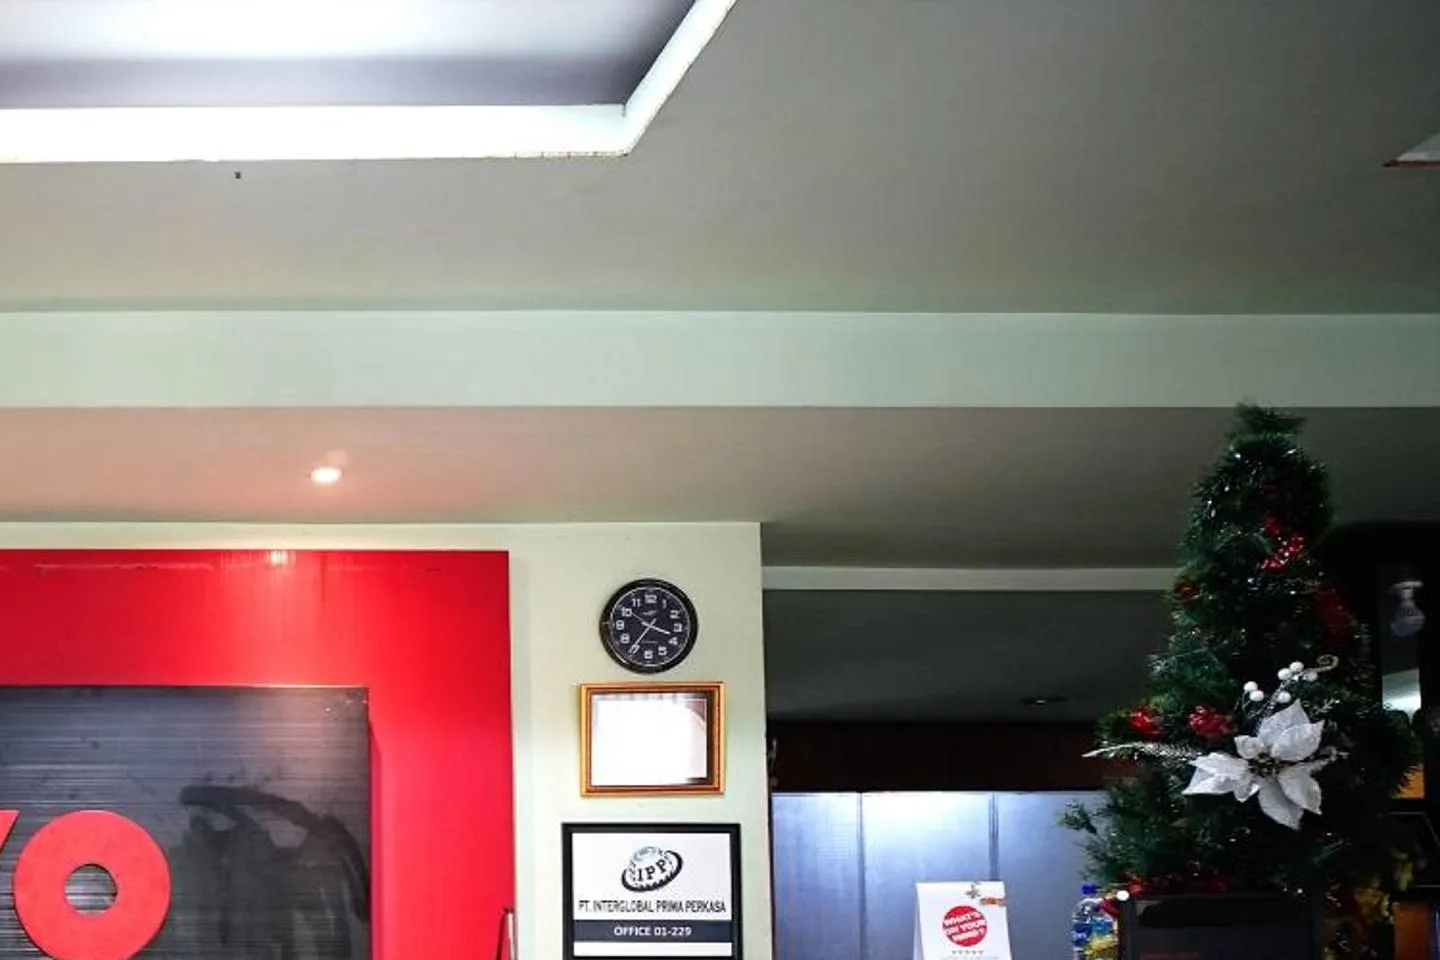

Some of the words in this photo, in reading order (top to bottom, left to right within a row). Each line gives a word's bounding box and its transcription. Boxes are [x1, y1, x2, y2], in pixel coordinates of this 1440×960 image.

[632, 599, 640, 607] 11
[644, 594, 657, 604] 12
[621, 606, 633, 617] 10
[670, 610, 680, 619] 2
[616, 620, 625, 630] 9
[673, 623, 682, 632] 3
[620, 633, 630, 644] 8
[668, 637, 678, 645] 4
[644, 649, 653, 659] 6
[658, 646, 667, 656] 5
[637, 858, 668, 882] IPP
[578, 899, 592, 913] PT.
[593, 899, 654, 913] INTERGLOBAL
[656, 899, 684, 913] PRIMA
[685, 899, 727, 913] PERKASA
[613, 926, 651, 937] OFFICE
[654, 926, 692, 937] 01-229
